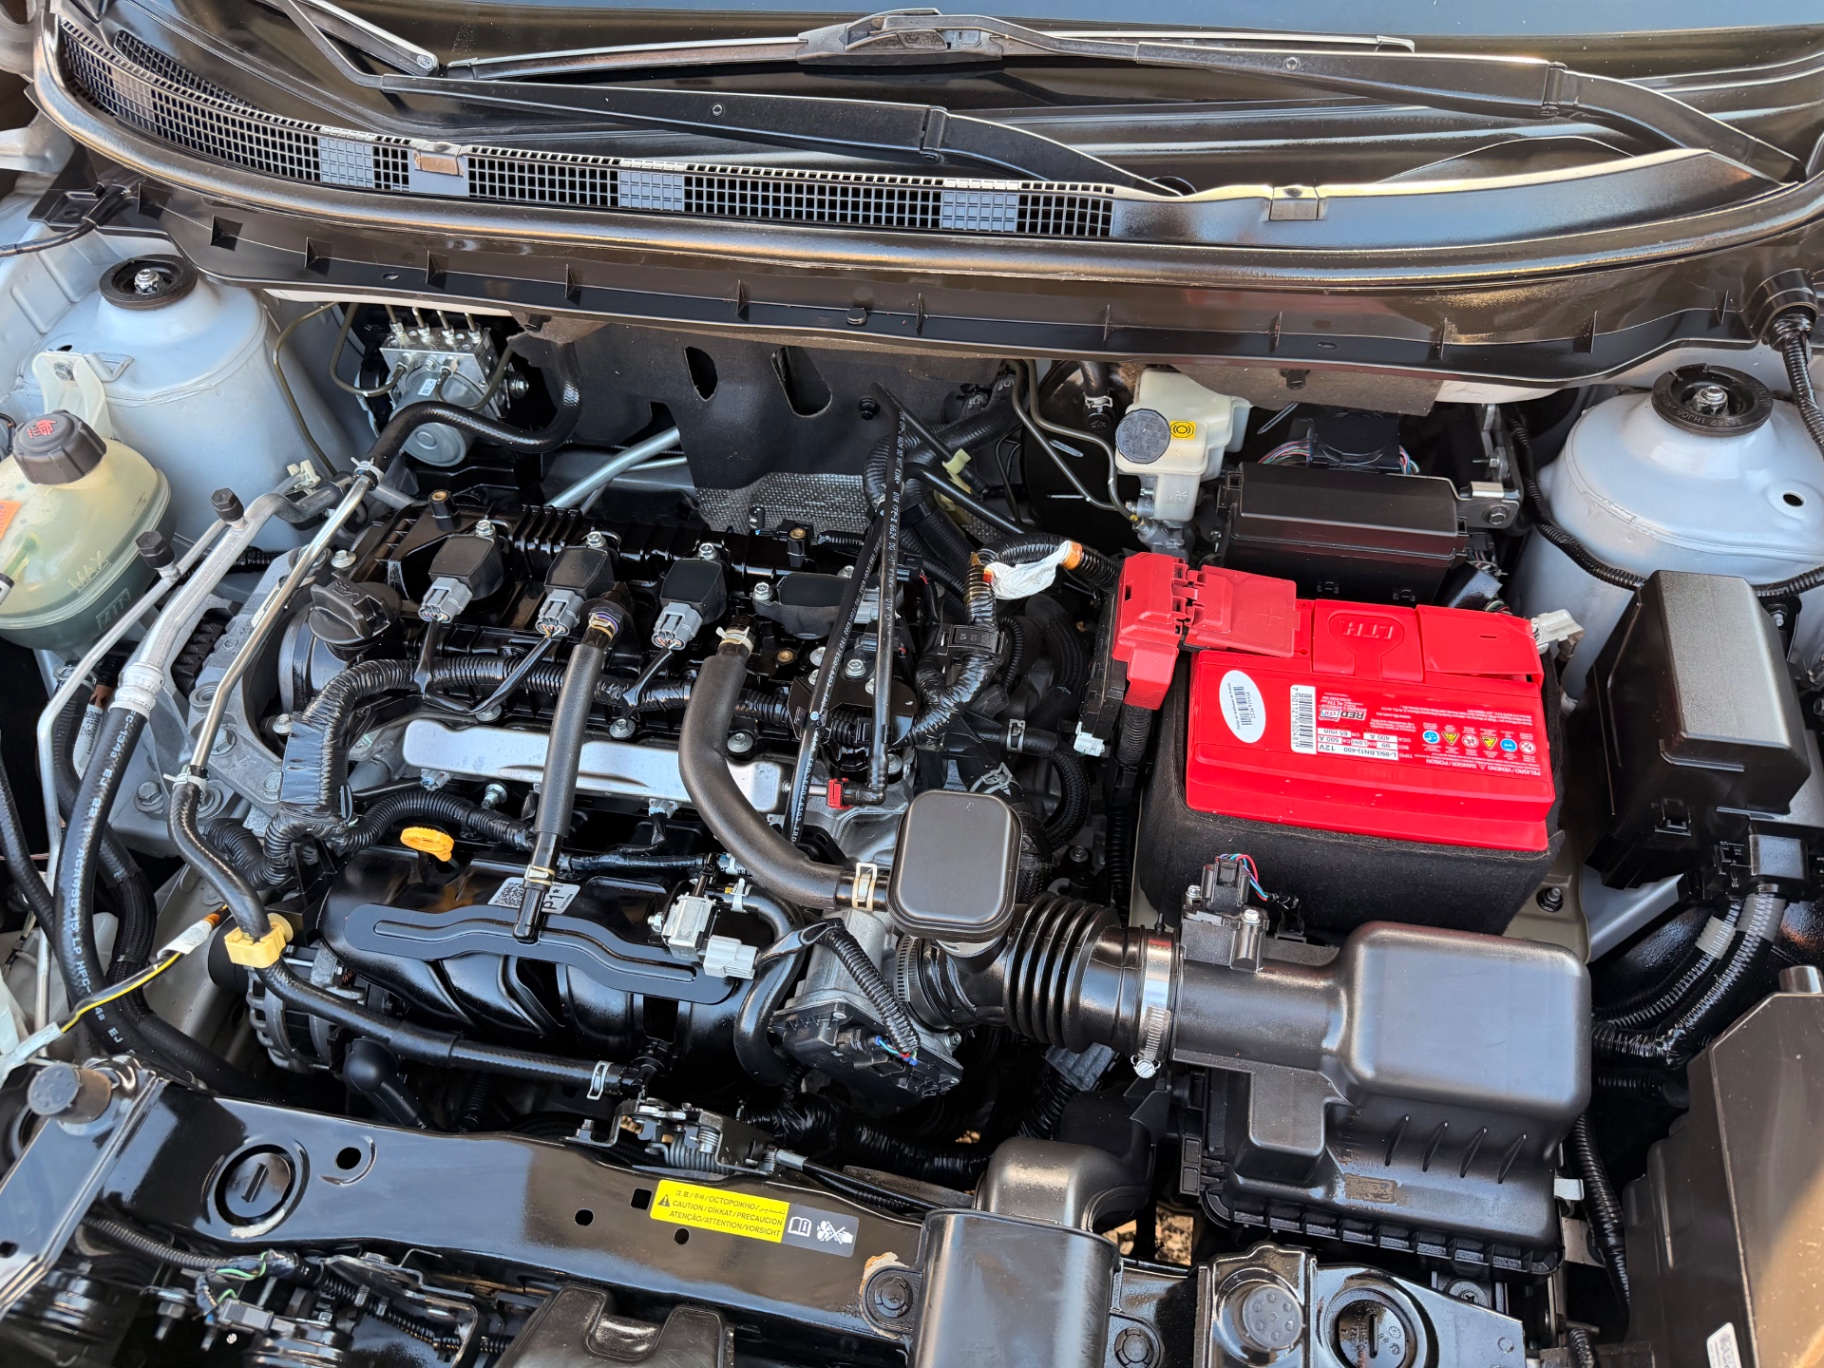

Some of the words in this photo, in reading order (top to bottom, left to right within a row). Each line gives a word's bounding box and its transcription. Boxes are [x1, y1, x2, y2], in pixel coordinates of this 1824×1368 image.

[889, 523, 898, 540] 6624
[67, 550, 108, 592] MAX
[1343, 621, 1394, 640] LTH
[1341, 711, 1364, 719] RED
[1320, 744, 1335, 752] 12V
[108, 1027, 123, 1043] EJ
[672, 1200, 704, 1212] CAUTION
